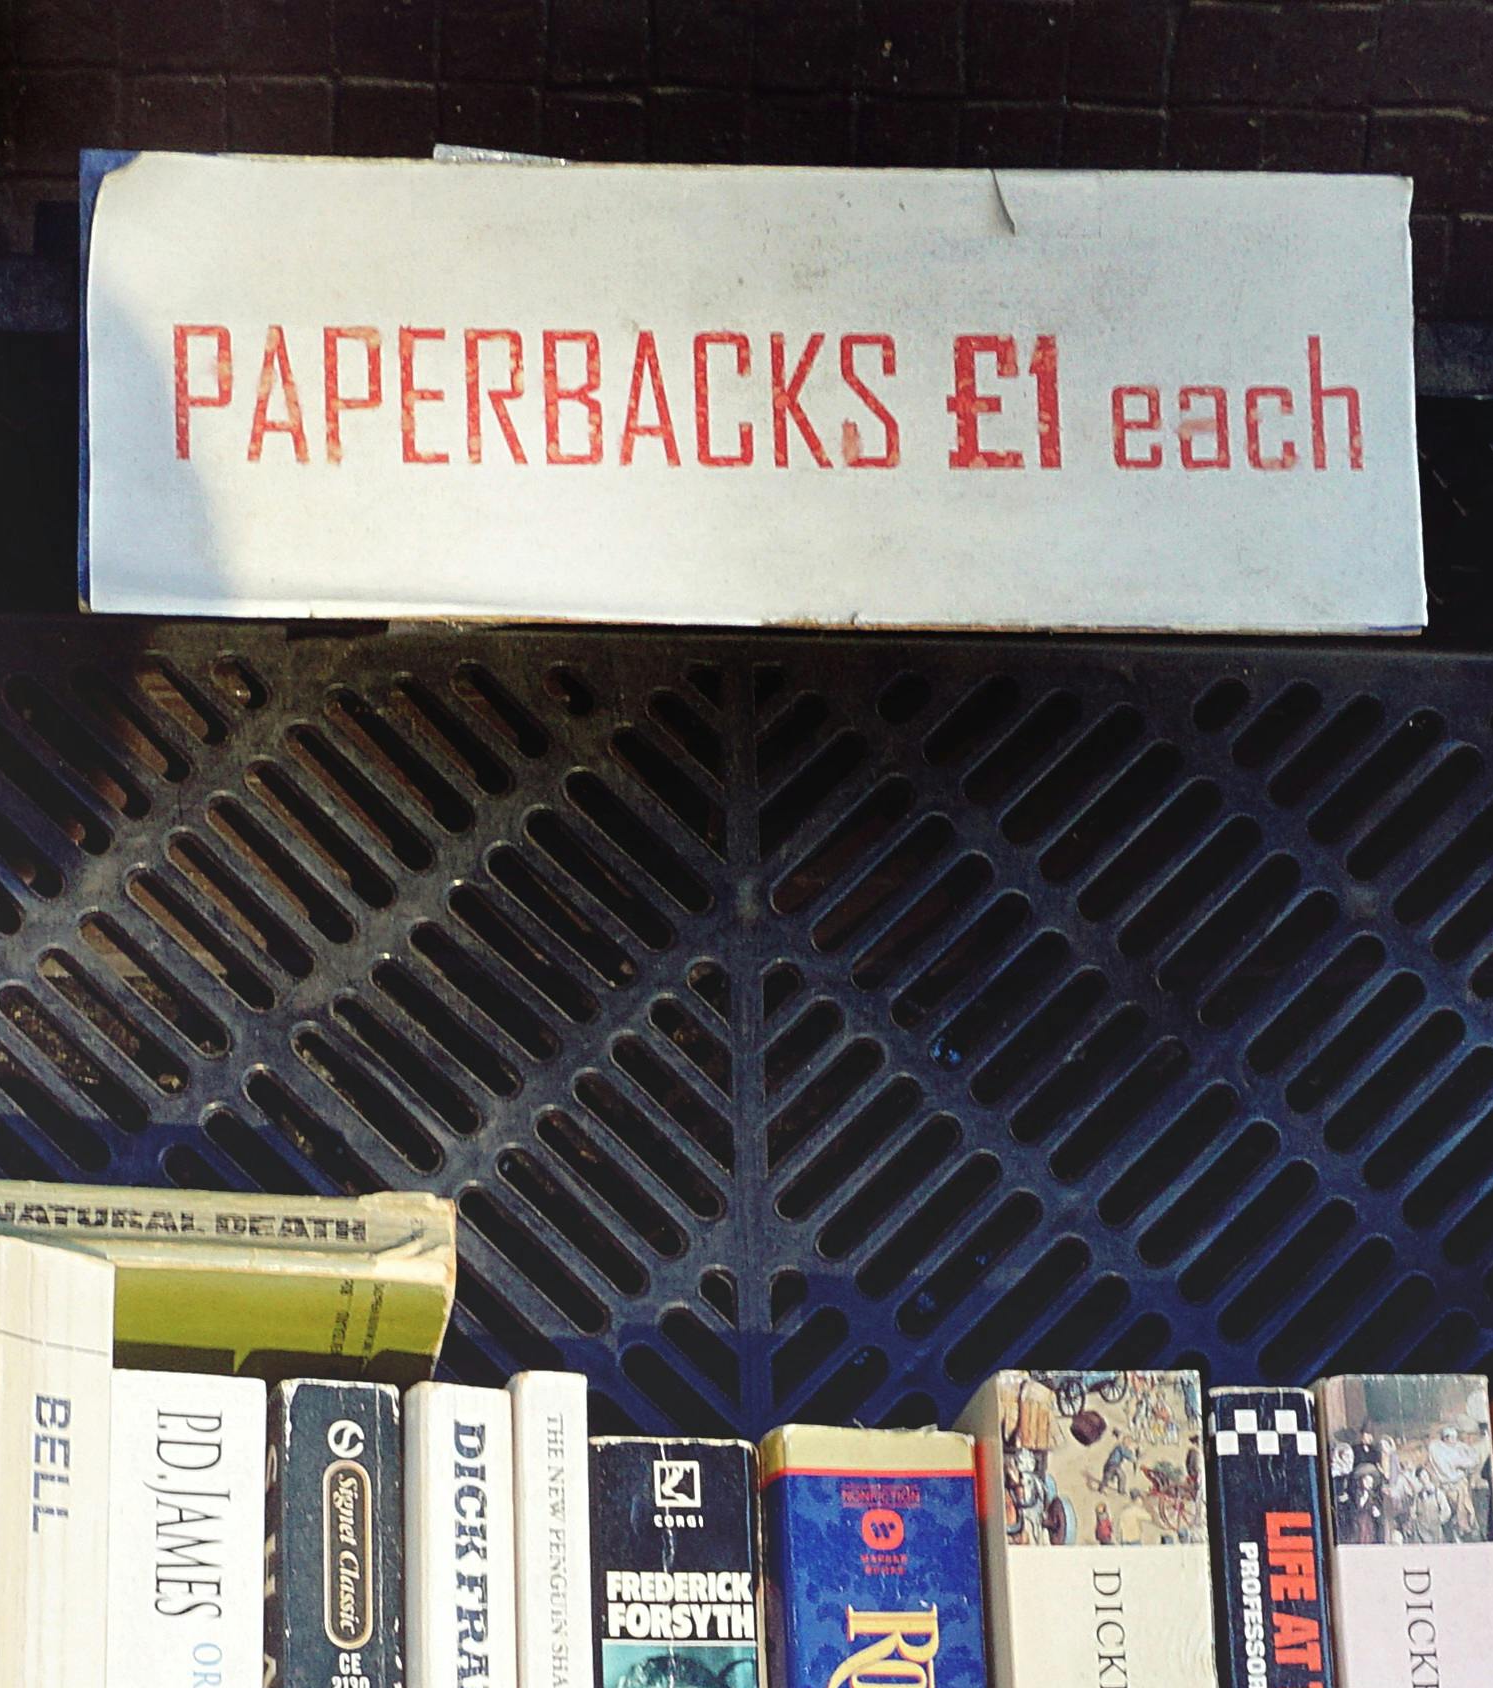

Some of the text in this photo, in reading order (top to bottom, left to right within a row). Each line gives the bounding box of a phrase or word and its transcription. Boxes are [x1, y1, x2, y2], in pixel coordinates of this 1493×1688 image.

[171, 323, 1364, 471] PAPERBACKS £1 each
[216, 1213, 368, 1243] DEATH
[32, 1393, 71, 1534] BELL
[547, 1413, 564, 1459] THE
[453, 1420, 487, 1571] DICK
[548, 1466, 566, 1528] NEW
[653, 1514, 704, 1528] CORGI
[143, 1480, 229, 1620] JAMES
[333, 1473, 359, 1637] Signet Classic
[1266, 1512, 1316, 1602] LIFE
[549, 1530, 568, 1637] PENGUIN
[606, 1570, 752, 1602] FREDERICK
[608, 1603, 757, 1639] FORSYTH
[1273, 1606, 1322, 1672] AT
[338, 1653, 362, 1675] CE
